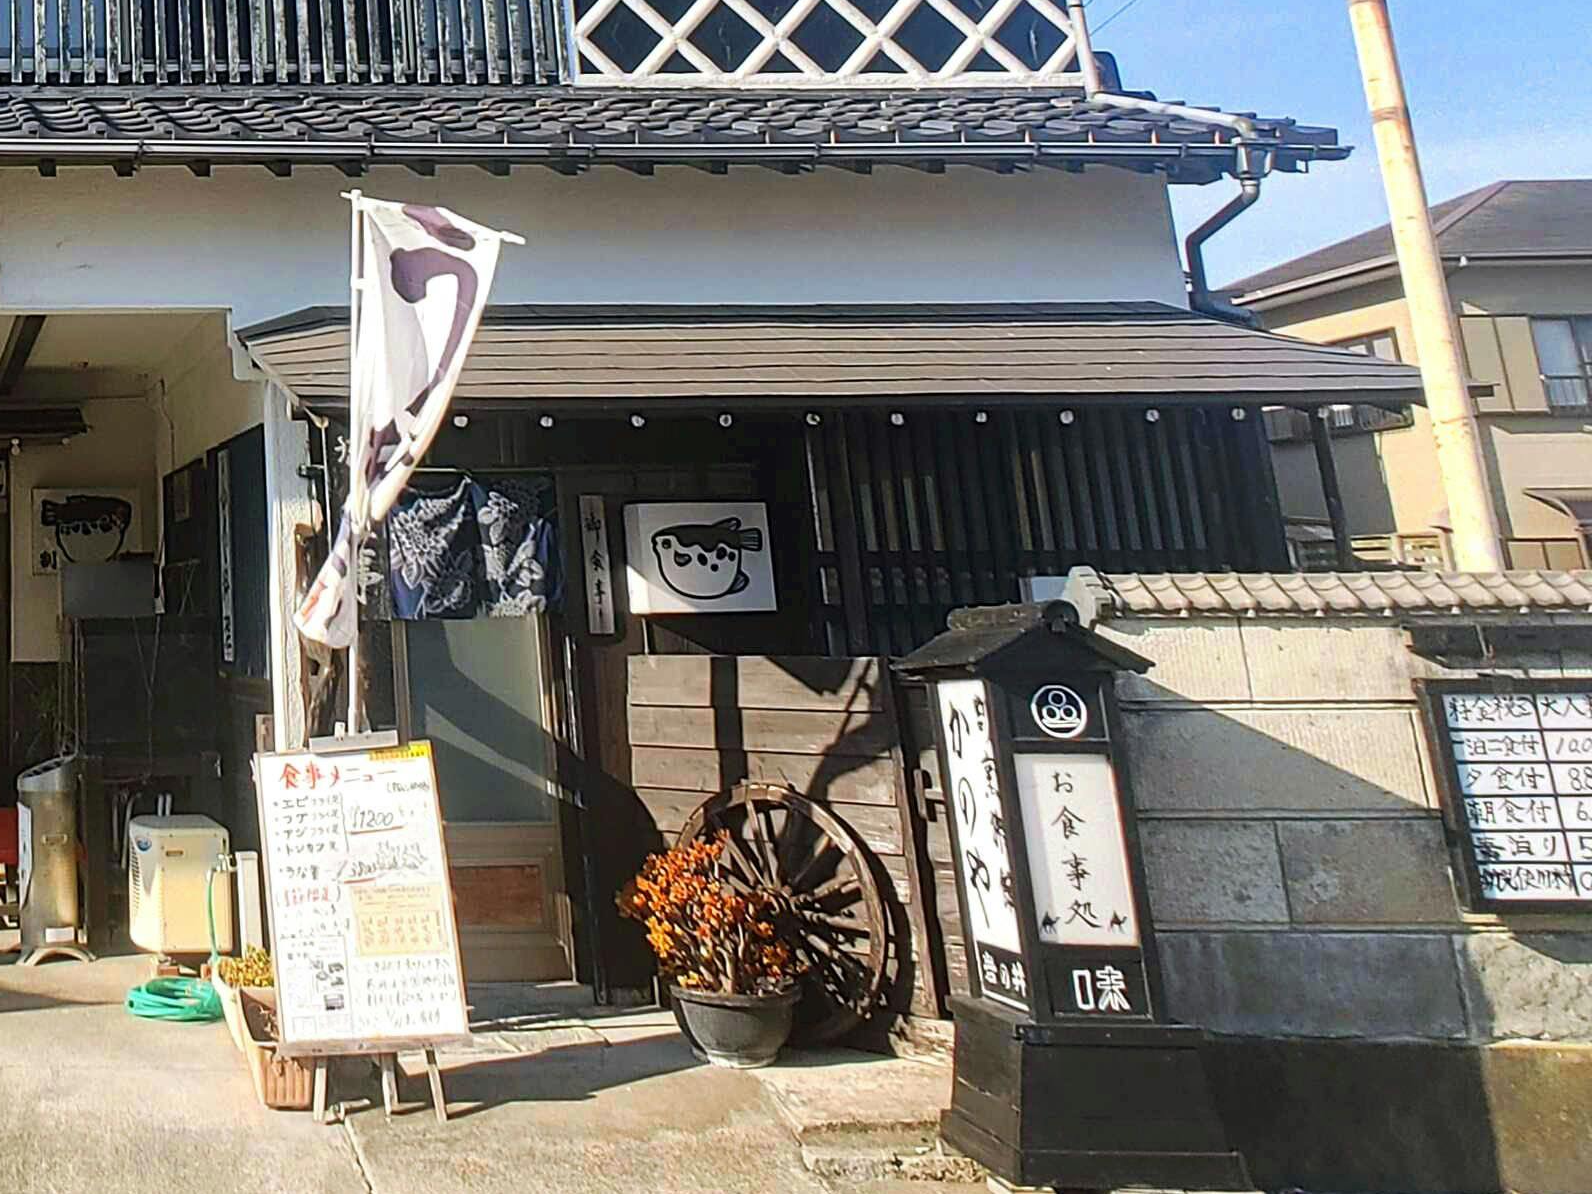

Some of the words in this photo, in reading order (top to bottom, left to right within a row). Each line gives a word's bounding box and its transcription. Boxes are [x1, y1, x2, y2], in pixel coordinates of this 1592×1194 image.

[1452, 734, 1540, 756] 一泊二食付
[280, 760, 397, 790] 食事メニュー
[1466, 766, 1545, 791] 夕食付
[948, 699, 991, 929] かのや
[1468, 799, 1551, 824] 朝食付
[1051, 771, 1101, 929] お食事処
[1474, 835, 1557, 861] 素泊り
[982, 949, 1027, 998] 岩の井
[1073, 965, 1131, 1012] 味
